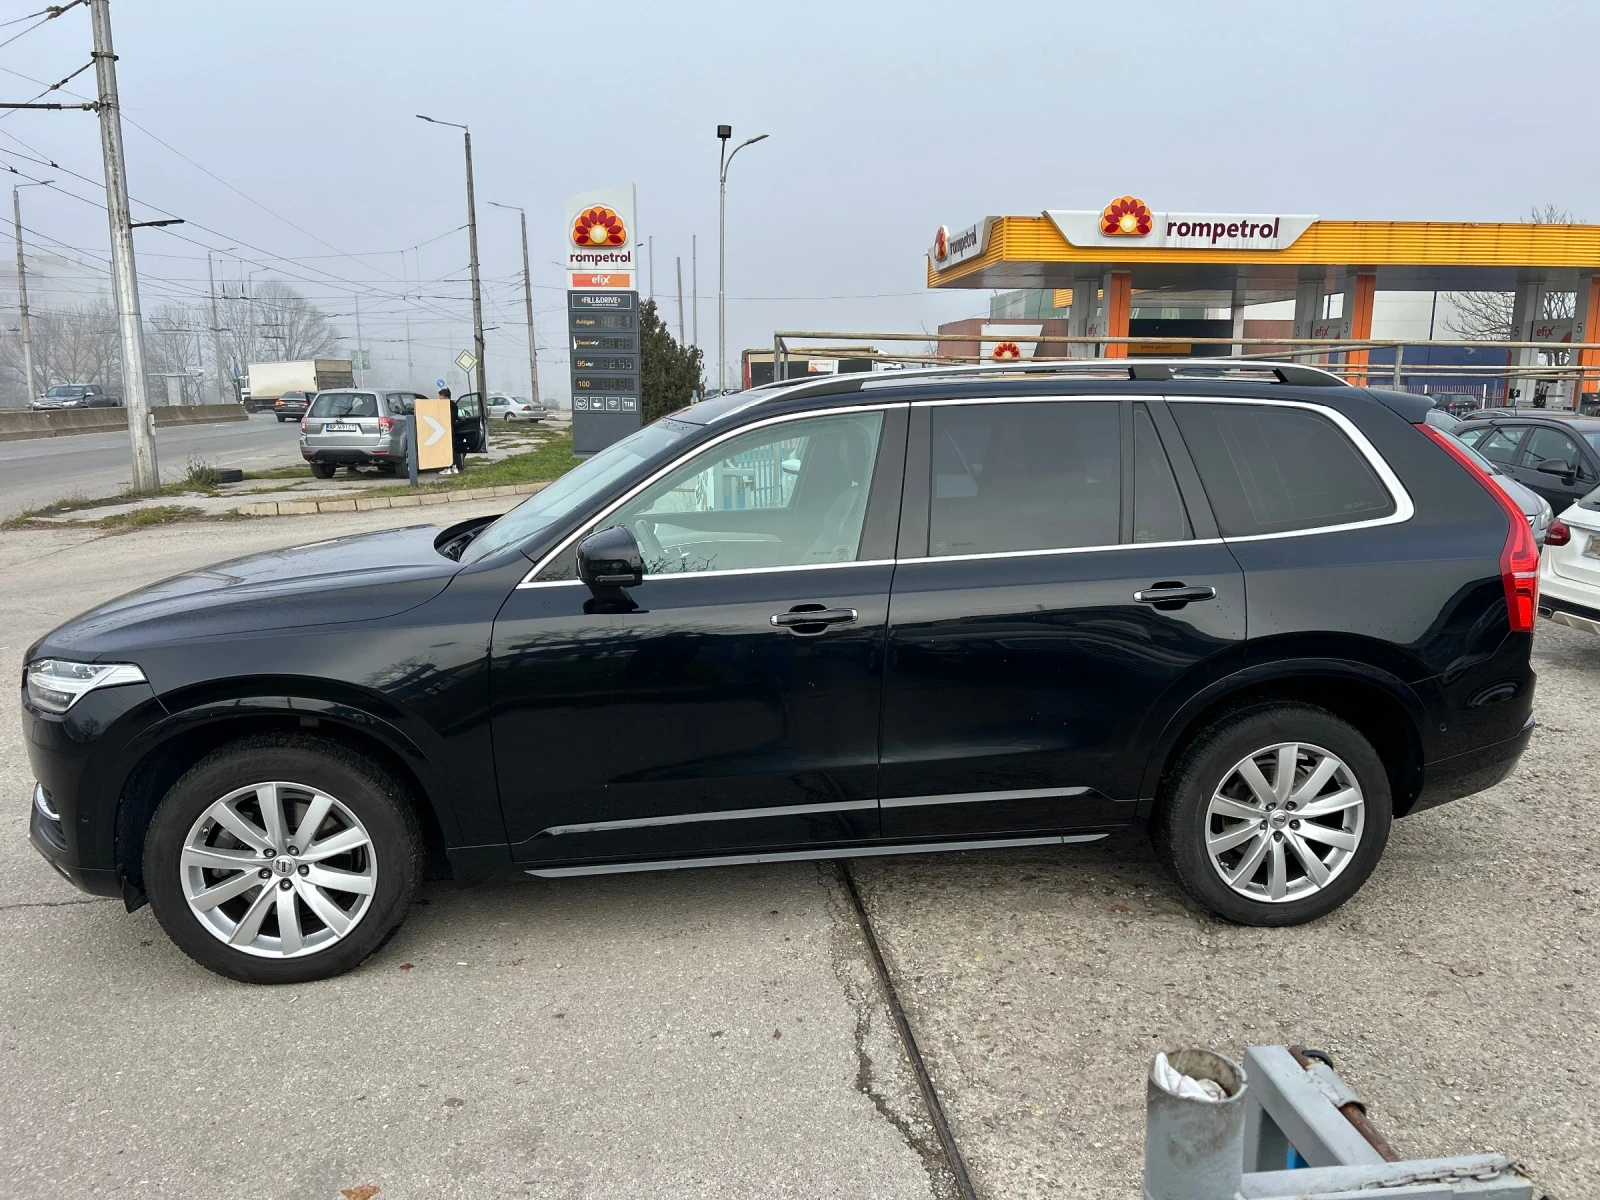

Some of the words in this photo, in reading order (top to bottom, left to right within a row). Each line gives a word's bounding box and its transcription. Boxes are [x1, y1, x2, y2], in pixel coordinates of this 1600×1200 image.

[1166, 217, 1280, 244] rompetrol
[949, 224, 977, 257] rompetrol
[570, 251, 631, 266] rompetrol
[591, 275, 611, 286] efix
[583, 296, 619, 304] FILL&DRIVE
[1295, 326, 1301, 337] 3
[1315, 325, 1330, 339] efix
[1343, 321, 1349, 334] 3
[1513, 326, 1520, 337] 5
[1536, 325, 1556, 339] efix
[1576, 322, 1583, 334] 5
